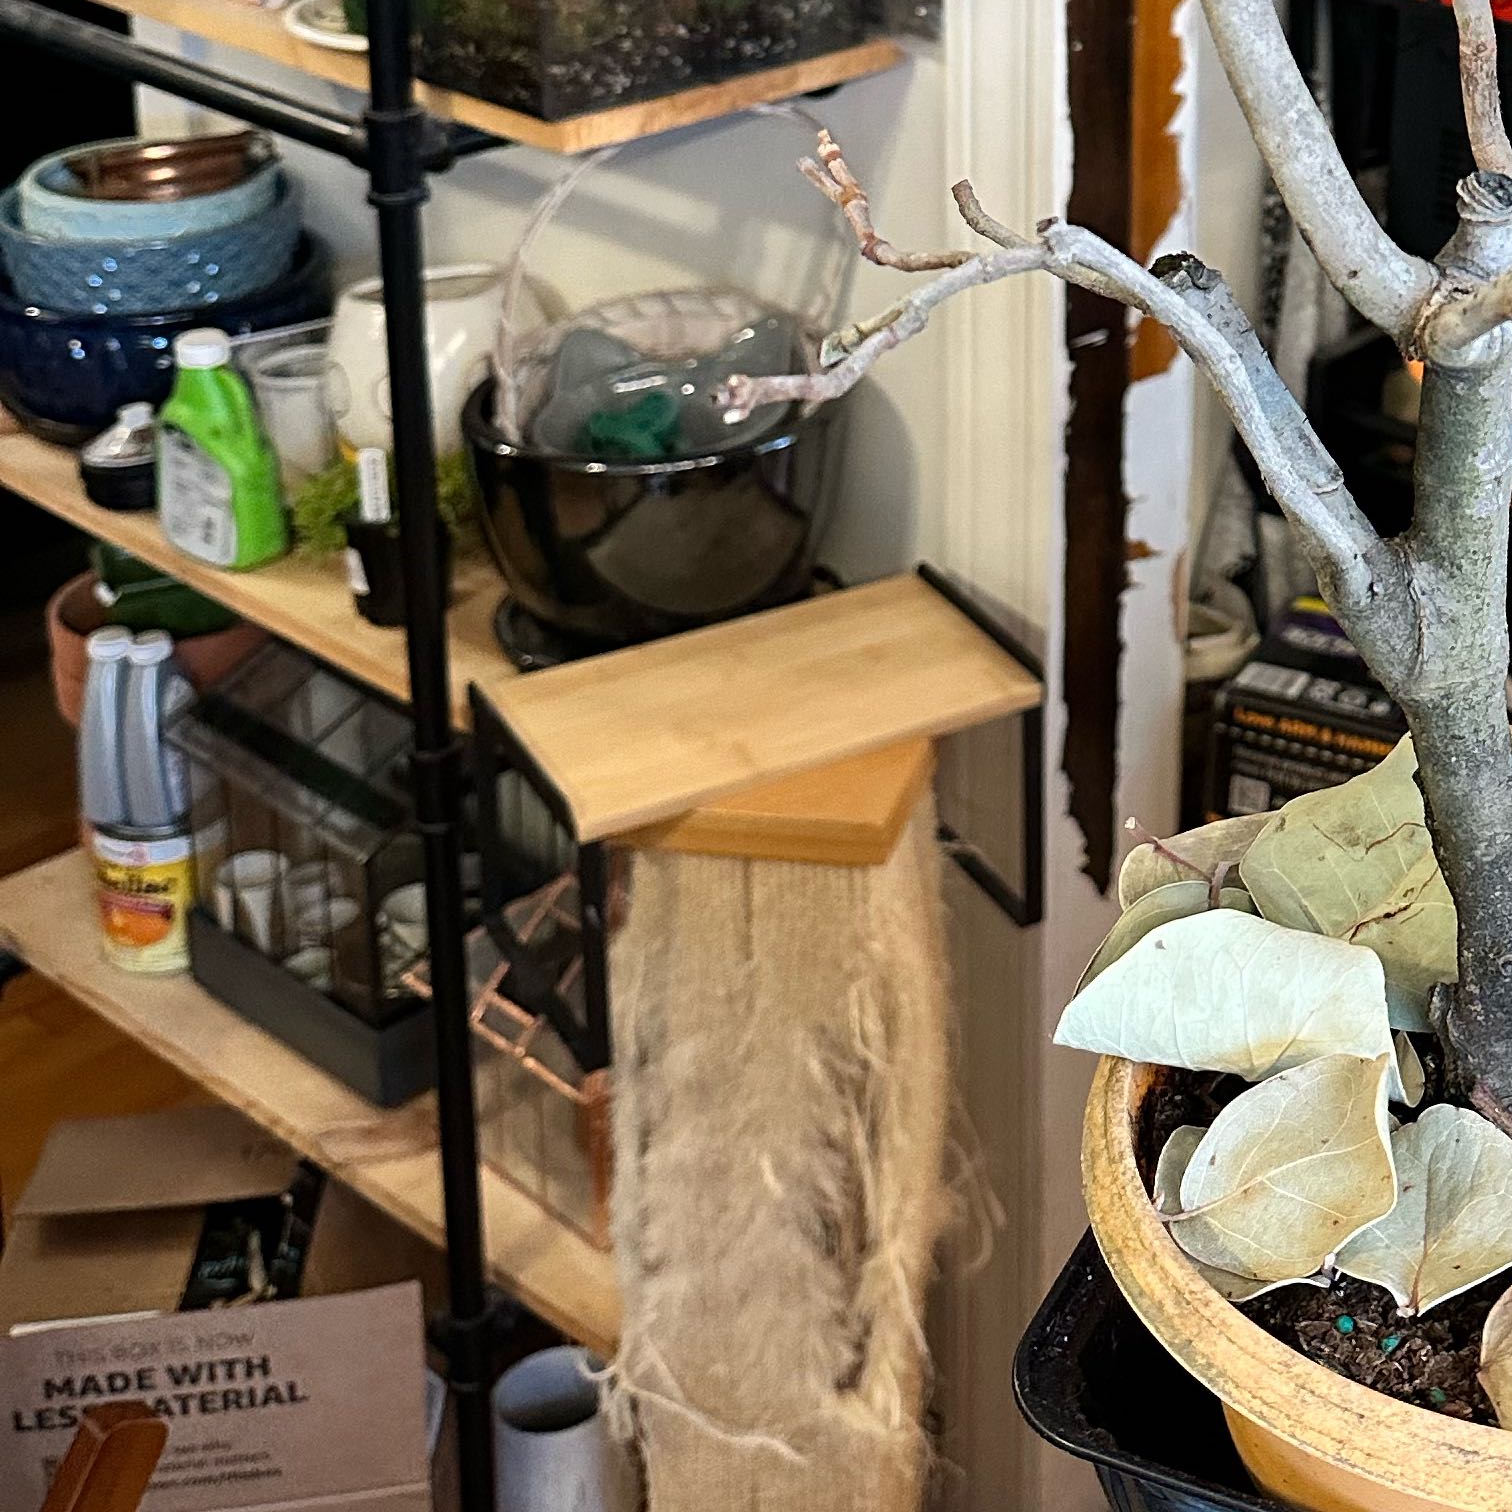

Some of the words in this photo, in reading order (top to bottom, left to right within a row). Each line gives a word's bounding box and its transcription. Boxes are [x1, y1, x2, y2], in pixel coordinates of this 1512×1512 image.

[194, 1332, 255, 1350] NOW
[42, 1366, 156, 1400] MADE
[165, 1354, 271, 1387] WITH
[12, 1402, 90, 1433] LES
[153, 1380, 310, 1418] ATERIAL
